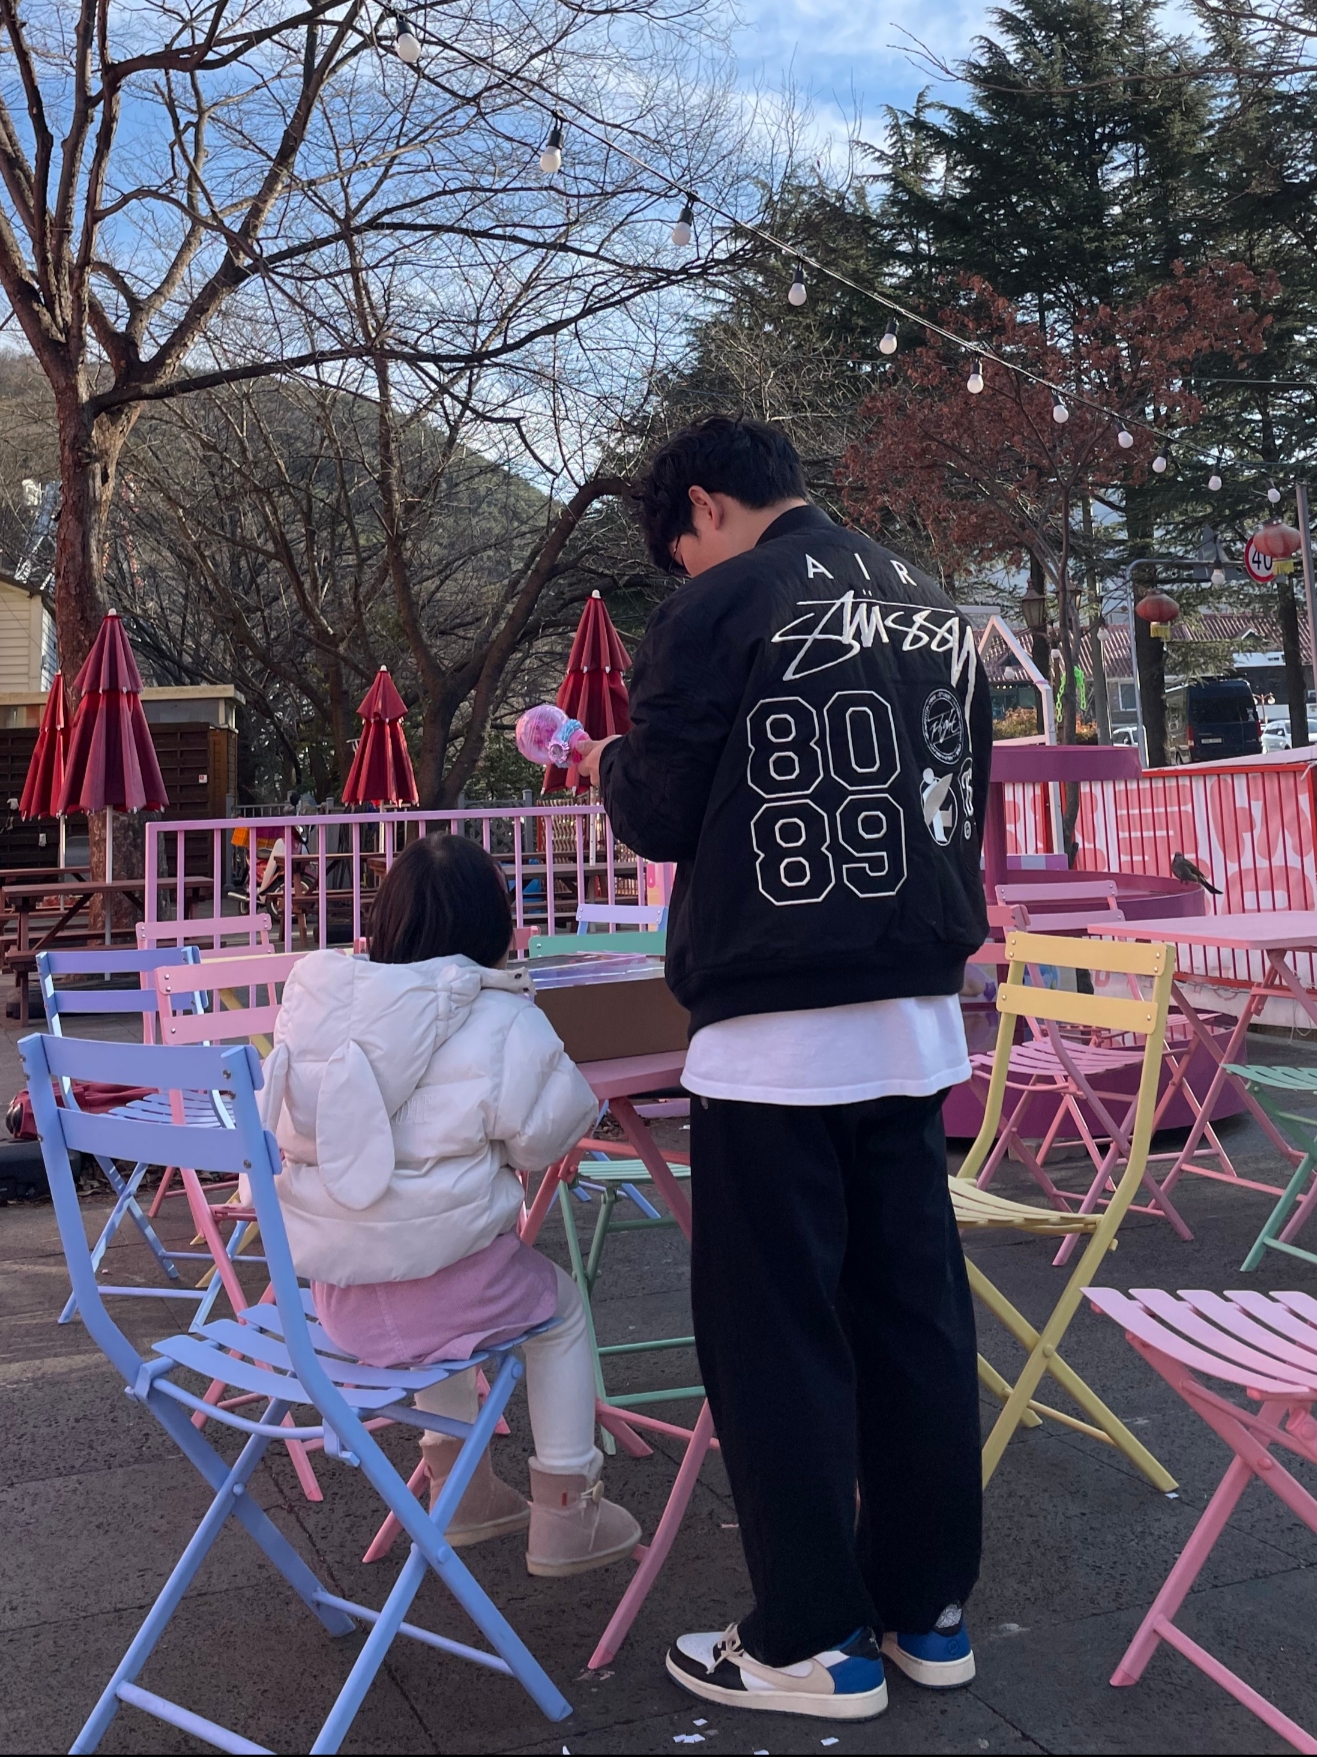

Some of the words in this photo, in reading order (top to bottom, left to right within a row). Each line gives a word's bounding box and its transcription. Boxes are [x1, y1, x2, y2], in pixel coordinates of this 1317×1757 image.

[805, 553, 916, 586] AIR
[1252, 551, 1273, 571] 40
[747, 690, 900, 799] 80
[751, 793, 907, 907] 89
